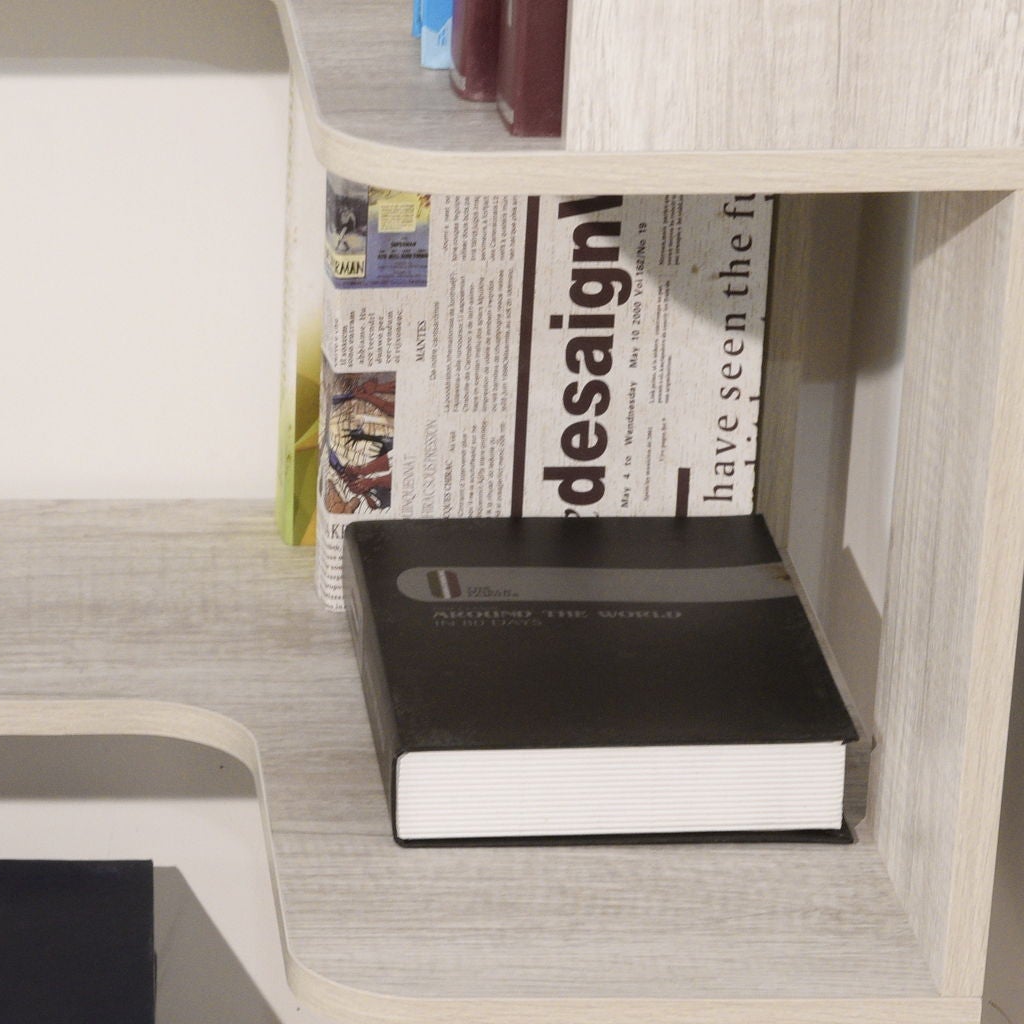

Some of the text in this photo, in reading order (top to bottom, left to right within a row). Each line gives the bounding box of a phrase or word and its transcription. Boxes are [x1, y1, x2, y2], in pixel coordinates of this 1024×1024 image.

[719, 234, 753, 297] the
[632, 300, 642, 326] 2000
[416, 320, 426, 361] MANTES
[632, 331, 641, 341] 10
[629, 347, 640, 369] May
[720, 312, 747, 405] seen
[624, 455, 632, 468] to
[703, 414, 739, 502] have
[621, 485, 632, 508] May
